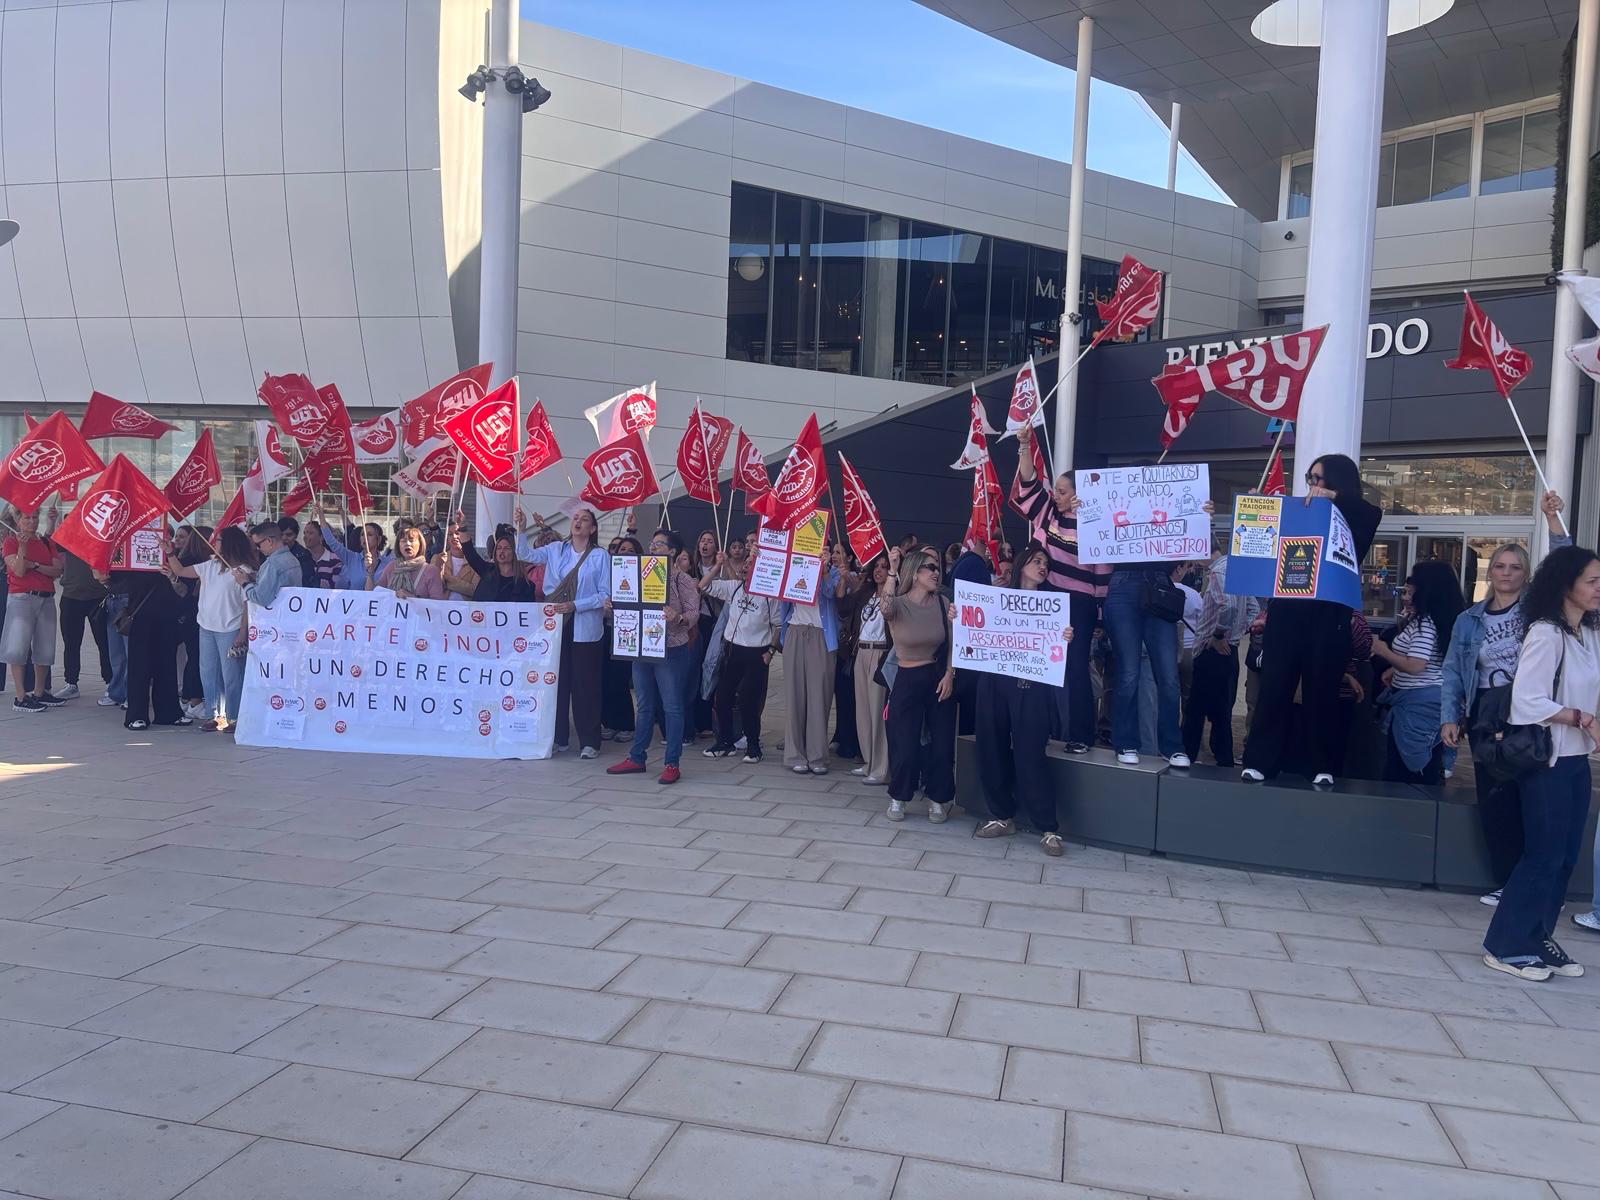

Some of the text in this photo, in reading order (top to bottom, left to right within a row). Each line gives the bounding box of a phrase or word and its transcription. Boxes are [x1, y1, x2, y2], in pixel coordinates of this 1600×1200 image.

[475, 405, 512, 443] UGT
[12, 442, 49, 472] UGT
[594, 451, 636, 487] UGT
[1082, 466, 1197, 488] ARTE DE QUITARNOS
[1107, 485, 1173, 500] LO GANADO,
[85, 493, 121, 530] UGT
[1098, 522, 1181, 541] DE QUITARNOS
[1089, 546, 1100, 557] LO
[1106, 545, 1124, 556] QUE
[1128, 542, 1143, 554] ES
[958, 591, 1061, 613] NUESTROS DERECHOS
[494, 611, 529, 627] DE
[961, 605, 1060, 631] NO SON UN PLUS
[321, 623, 400, 645] ARTE
[443, 634, 500, 659] ¡NO!
[990, 652, 998, 660] DE
[1000, 650, 1029, 663] BORRAR
[1030, 656, 1046, 665] AÑOS
[997, 663, 1007, 672] DE
[259, 658, 514, 687] NI UN DERECHO
[337, 691, 463, 715] MENOS
